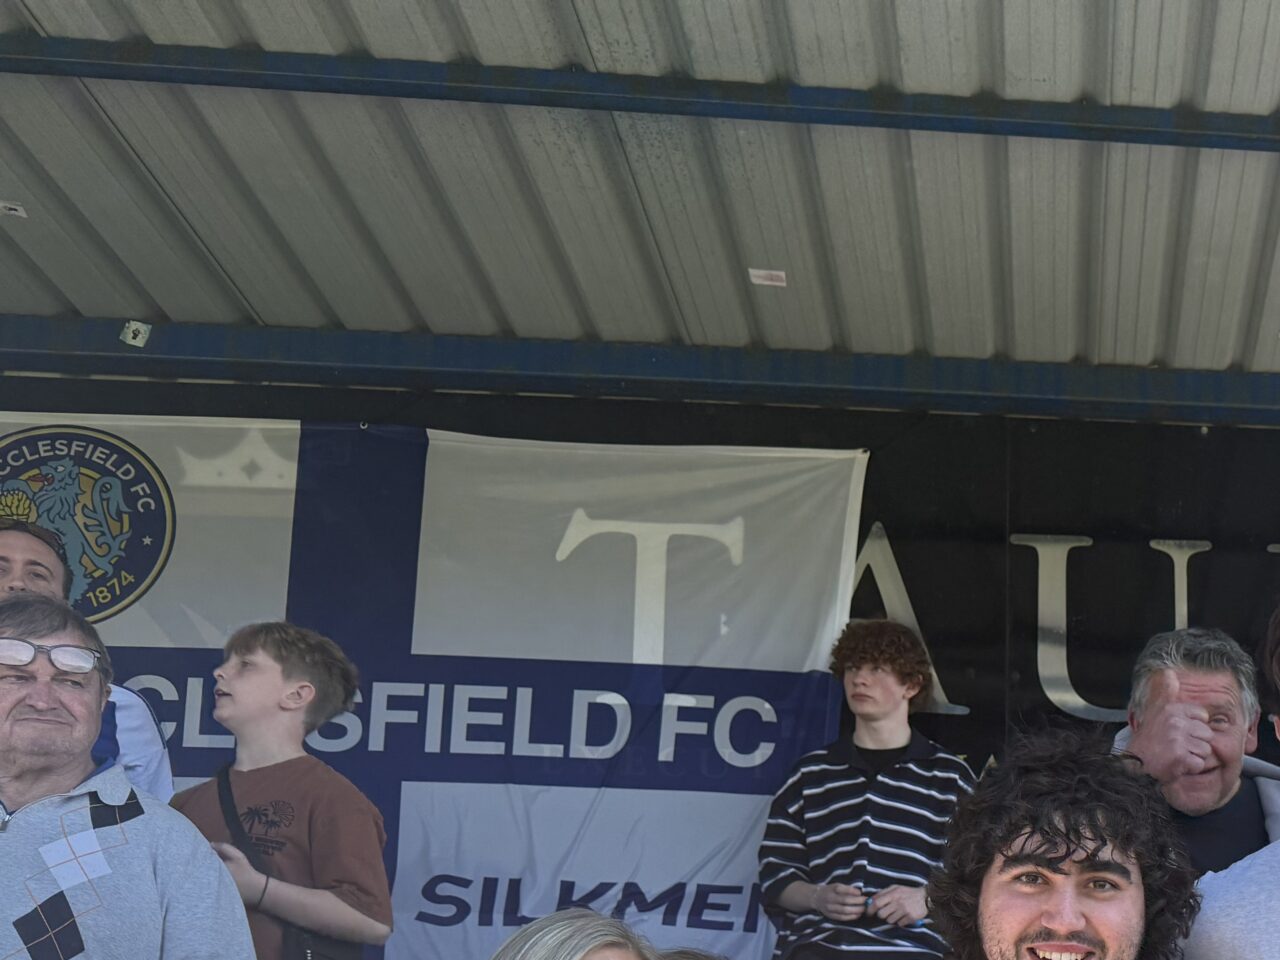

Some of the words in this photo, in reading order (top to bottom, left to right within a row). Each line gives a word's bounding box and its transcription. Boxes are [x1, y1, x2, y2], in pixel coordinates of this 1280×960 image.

[130, 482, 156, 513] FC
[86, 570, 135, 608] 1874
[657, 692, 778, 769] FC
